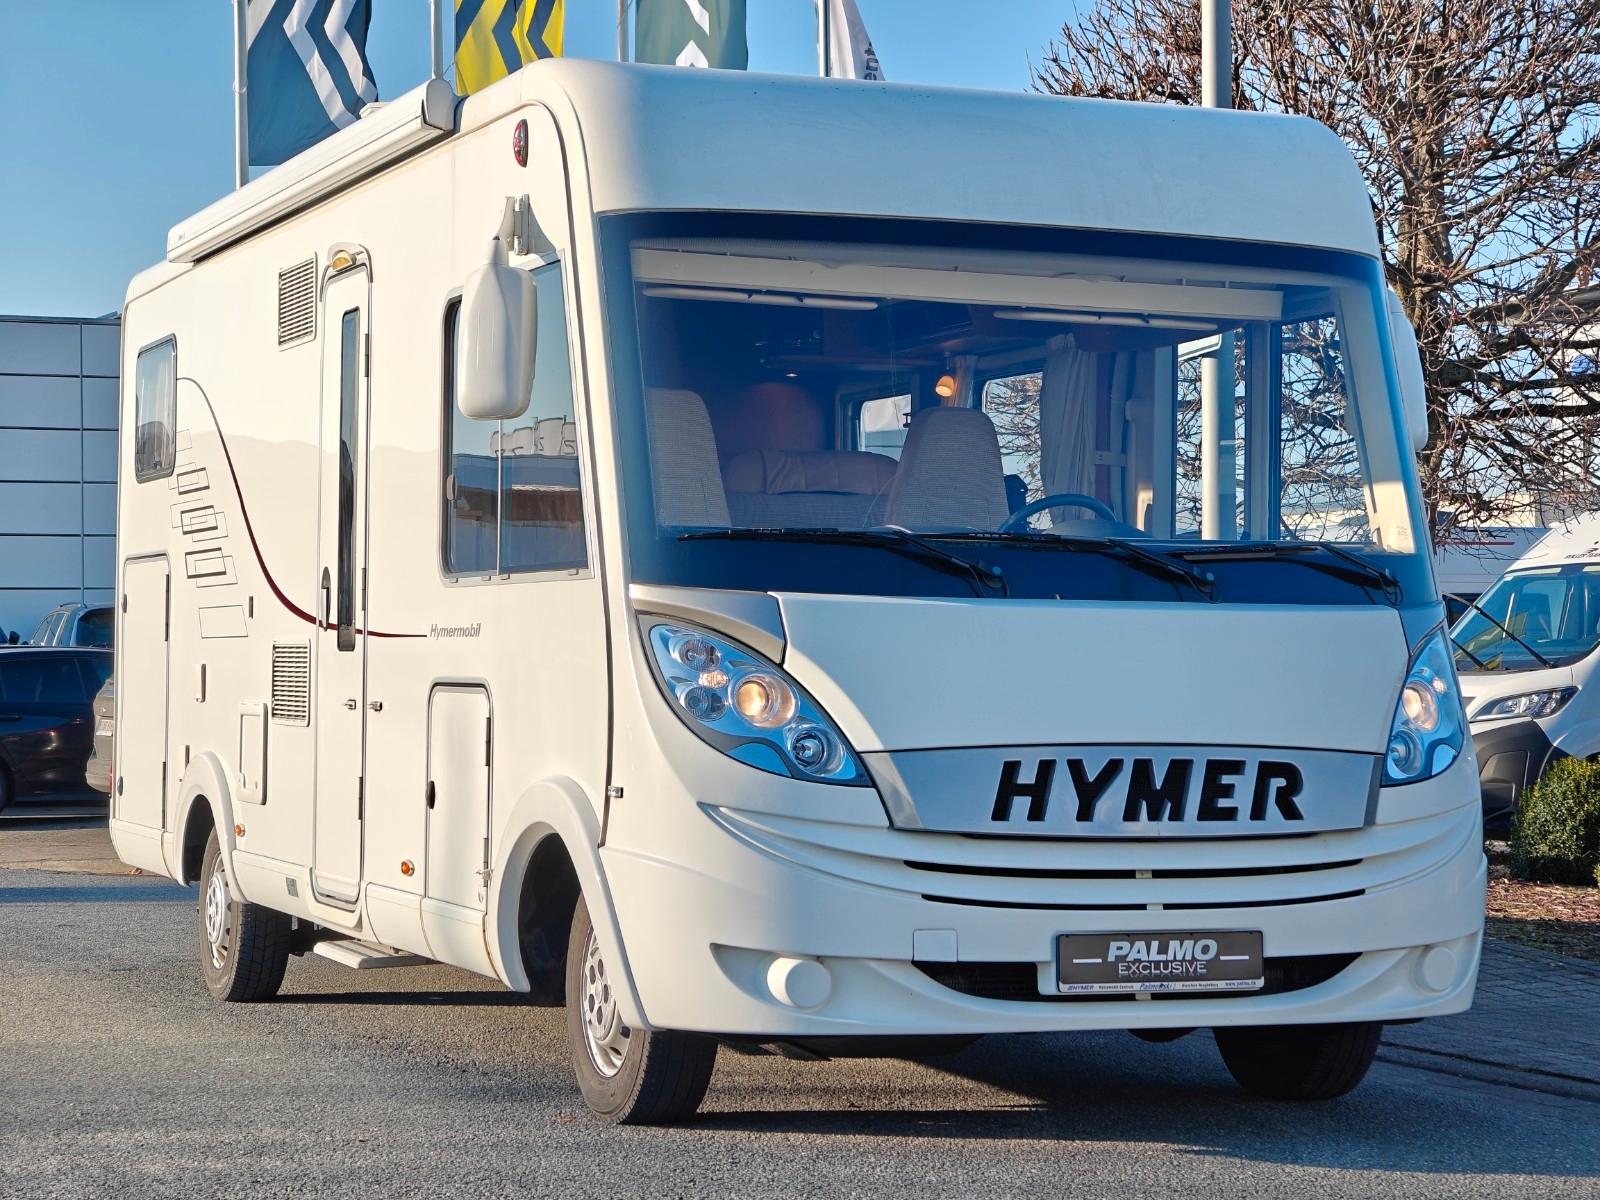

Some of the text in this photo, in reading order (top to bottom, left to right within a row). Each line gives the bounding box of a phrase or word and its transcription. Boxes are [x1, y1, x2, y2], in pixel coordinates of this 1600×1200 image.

[430, 622, 482, 641] Hymermobil
[990, 757, 1305, 822] HYMER
[1107, 939, 1218, 962] PALMO
[1118, 961, 1207, 974] EXCLUSIVE
